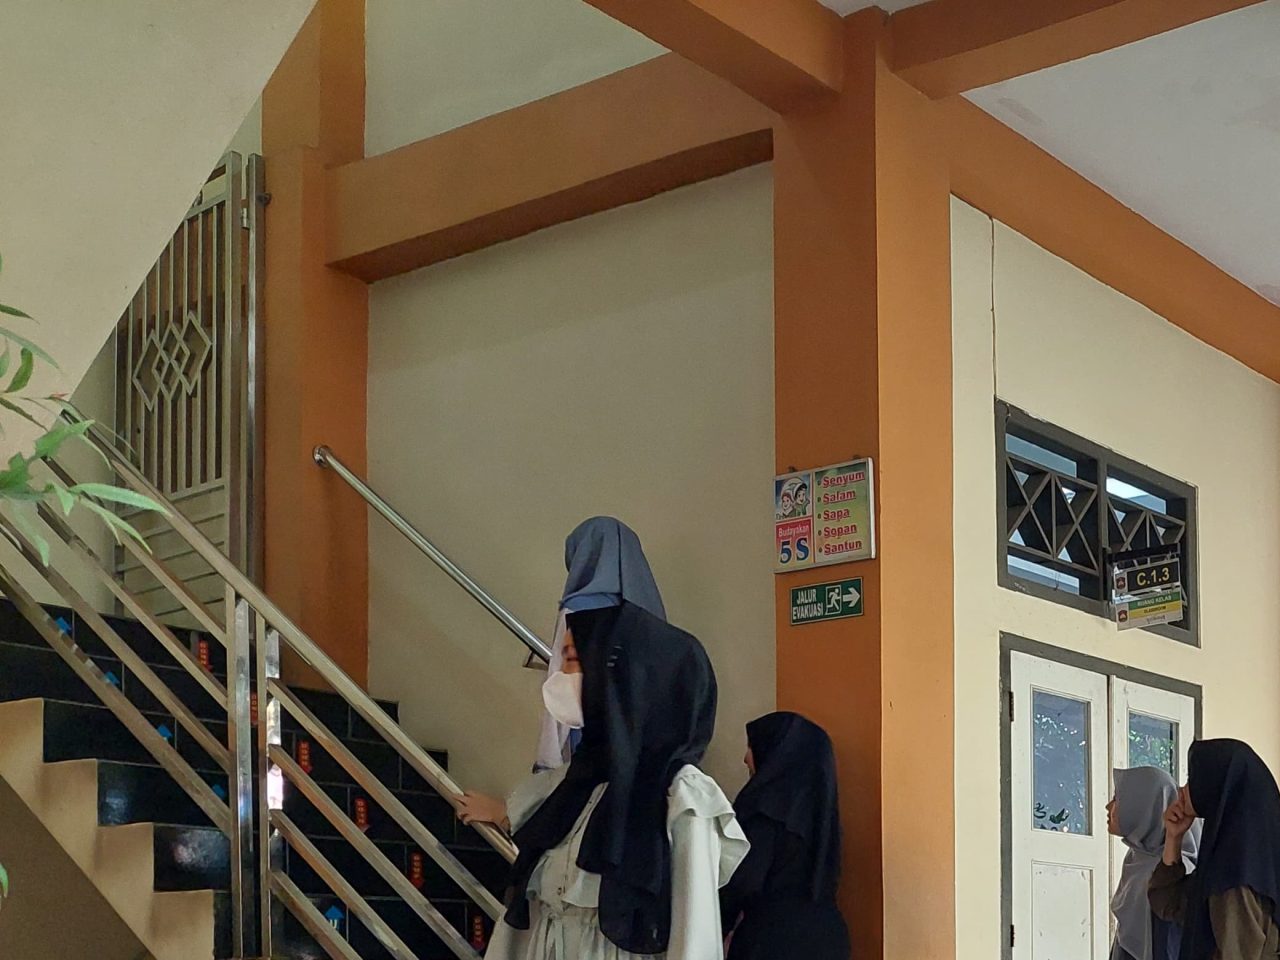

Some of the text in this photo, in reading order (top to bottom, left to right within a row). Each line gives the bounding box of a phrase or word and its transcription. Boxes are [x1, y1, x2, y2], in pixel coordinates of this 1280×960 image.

[823, 470, 865, 488] Senyum
[823, 489, 856, 504] Salam
[823, 507, 850, 522] Sapa
[778, 524, 810, 538] Budayakan
[823, 523, 857, 539] Sopan
[824, 539, 863, 555] Santun
[1136, 567, 1170, 586] C.1.3
[796, 588, 817, 604] JALUR
[792, 602, 824, 620] EVAKUASI
